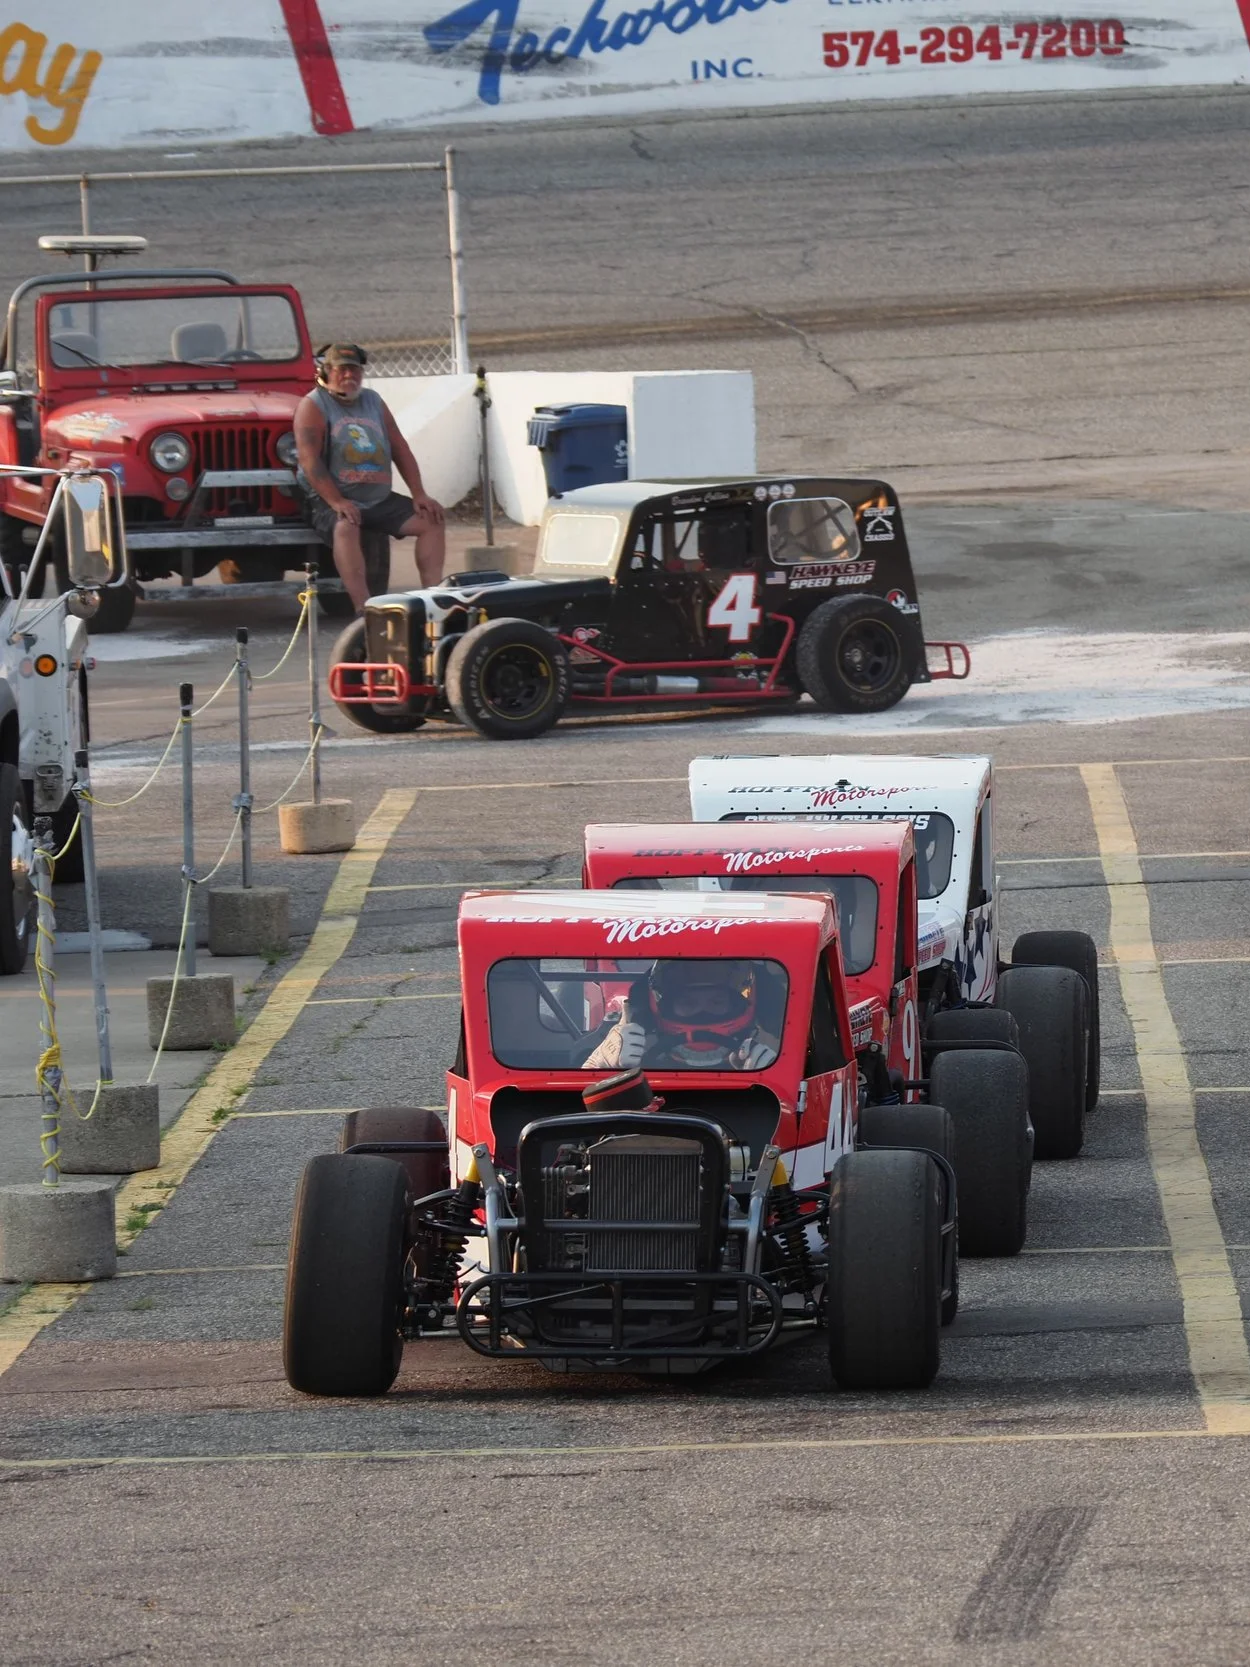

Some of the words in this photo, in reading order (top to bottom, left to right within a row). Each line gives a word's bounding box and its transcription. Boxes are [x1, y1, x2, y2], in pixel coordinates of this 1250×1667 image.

[821, 18, 1126, 68] 574-294-7200
[690, 58, 764, 81] INC.
[789, 560, 876, 580] HAWKEYE
[789, 577, 832, 590] SPEED
[836, 574, 873, 587] SHOP
[706, 572, 763, 644] 4
[722, 843, 867, 873] Motorsports
[903, 999, 917, 1104] 9
